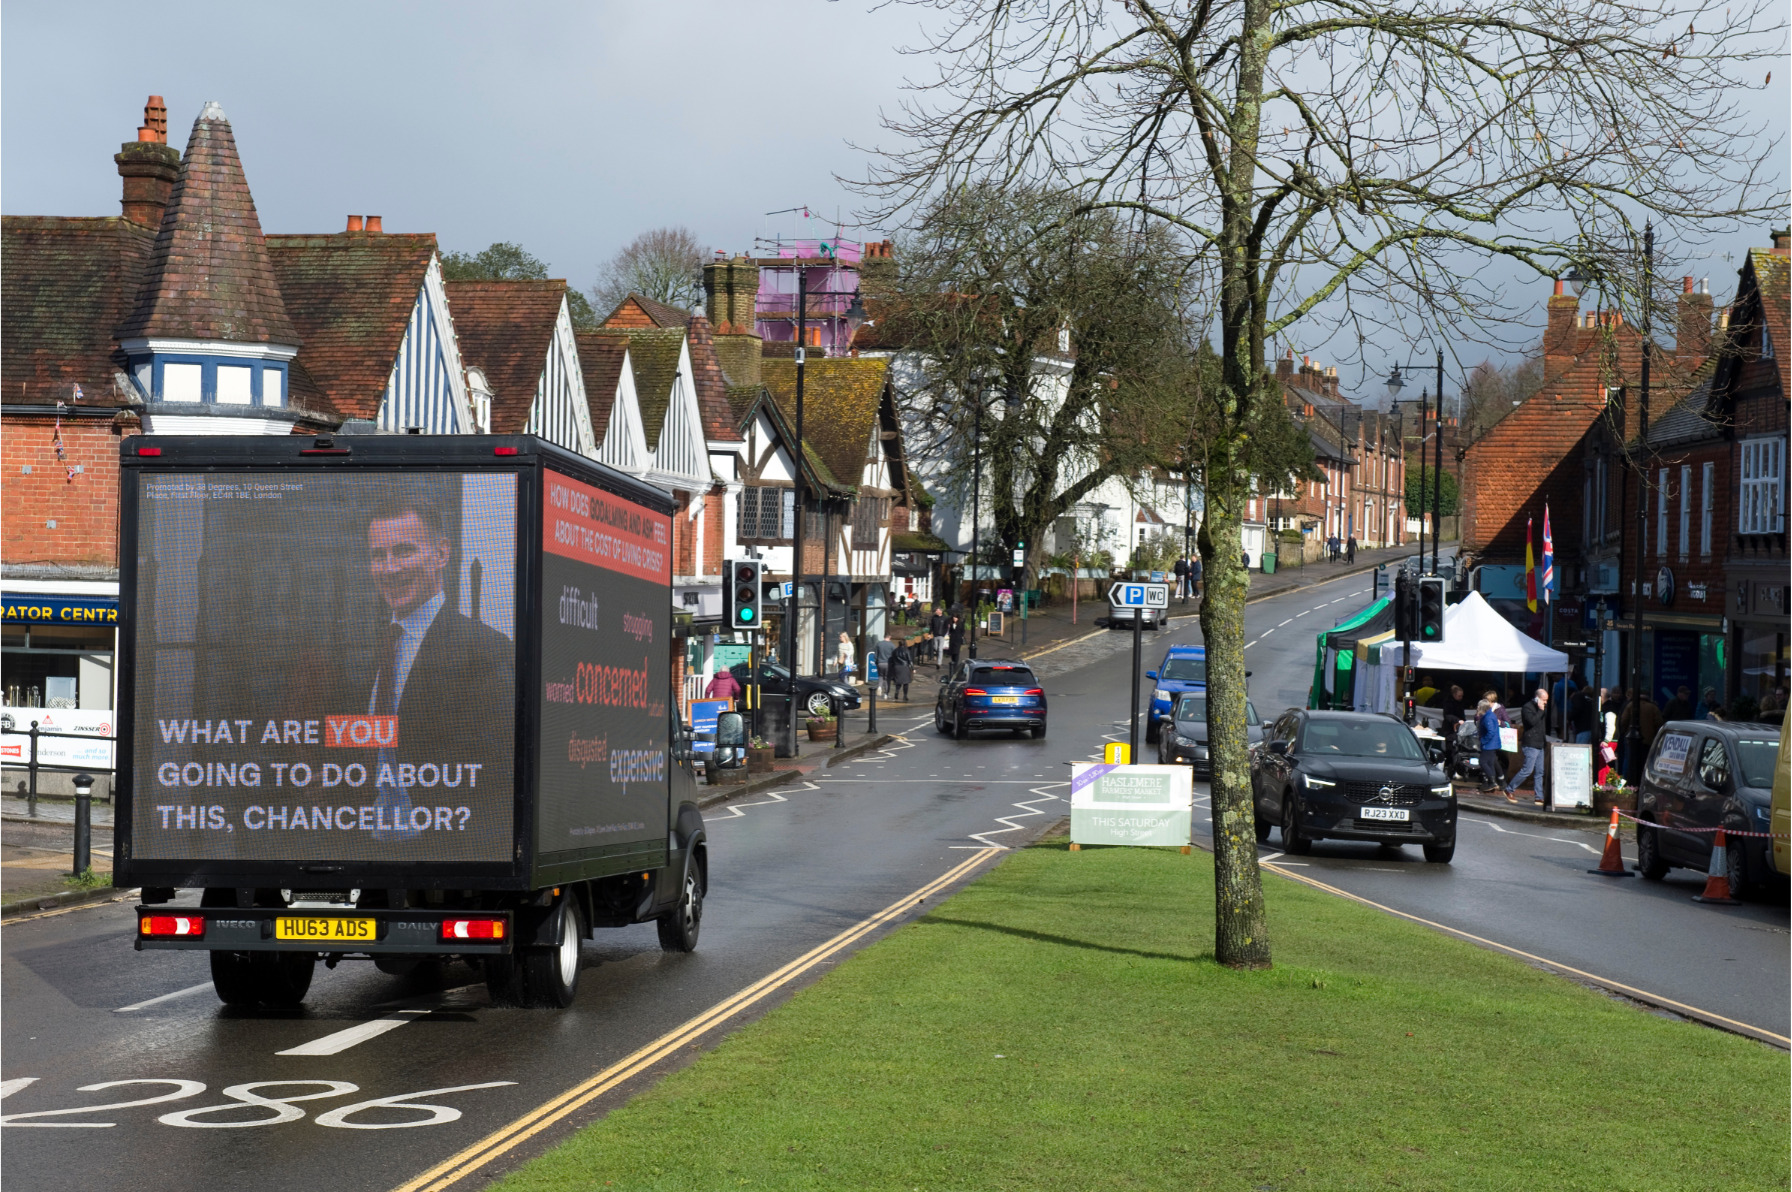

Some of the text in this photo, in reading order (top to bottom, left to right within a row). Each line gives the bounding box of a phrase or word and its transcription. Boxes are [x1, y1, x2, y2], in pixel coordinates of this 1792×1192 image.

[146, 483, 184, 491] Promoted
[185, 483, 194, 493] by
[242, 483, 252, 491] 10
[254, 483, 278, 491] Queen
[280, 483, 303, 491] Street
[253, 491, 282, 499] London
[550, 481, 570, 510] HOW
[570, 489, 589, 518] DOES
[655, 520, 667, 545] FEEL
[555, 519, 663, 573] ABOUT THE COST OF LIVING CRISIS?
[1149, 591, 1163, 601] WC
[559, 584, 598, 631] difficult
[623, 611, 652, 643] struggling
[545, 677, 574, 704] worried
[576, 656, 648, 709] concerned
[37, 725, 63, 733] enjamin
[158, 719, 395, 744] WHAT ARE YOU
[28, 748, 66, 757] Snderson
[569, 730, 608, 770] disgusted
[1663, 735, 1690, 754] KENDALL
[157, 762, 482, 788] GOING TO DO ABOUT
[610, 739, 664, 795] expensive
[1101, 776, 1163, 788] HASLEMERE
[1134, 787, 1162, 796] MARKET
[157, 805, 471, 833] THIS, CHANCELLOR?
[1092, 816, 1170, 828] THIS SATURDAY
[1364, 809, 1405, 819] RJ23 XXD
[1110, 828, 1152, 838] High Street
[216, 920, 256, 929] IVECO
[284, 919, 368, 937] HU63 ADS
[397, 921, 438, 931] DAILY
